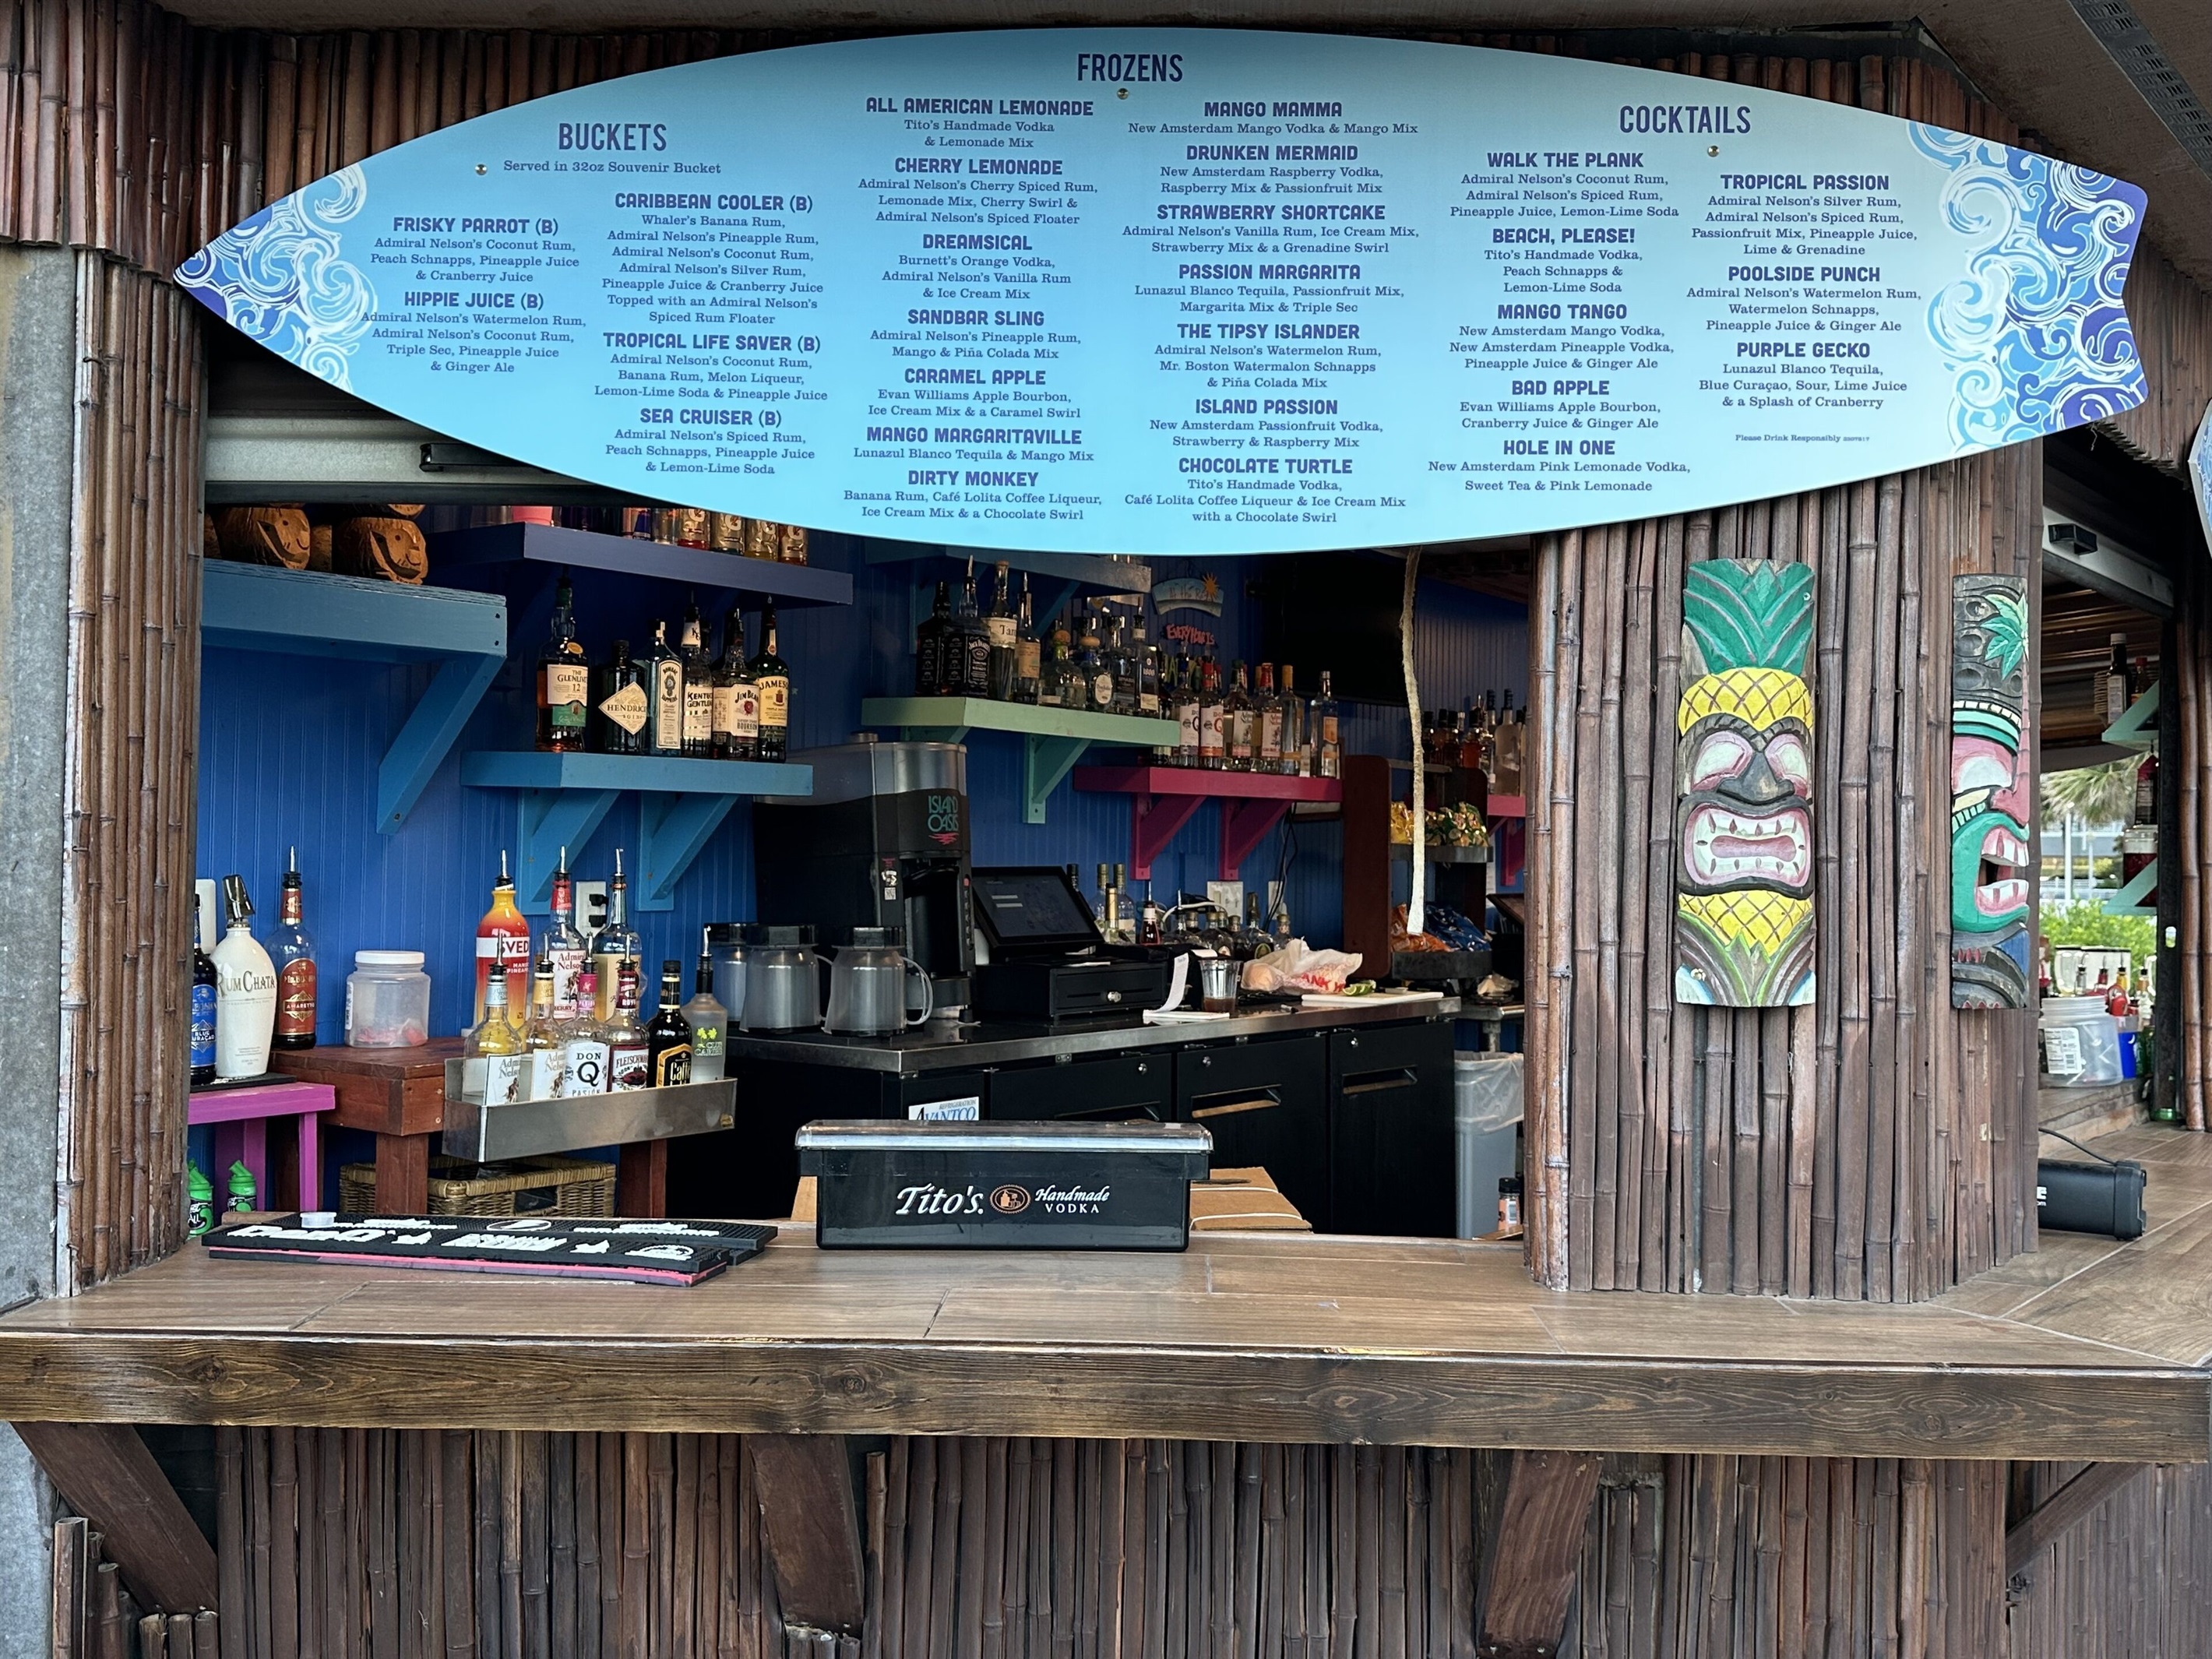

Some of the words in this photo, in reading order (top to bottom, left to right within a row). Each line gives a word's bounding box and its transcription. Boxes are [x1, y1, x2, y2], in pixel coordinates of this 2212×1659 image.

[1078, 54, 1183, 82] FROZENS
[866, 97, 898, 113] ALL
[903, 97, 992, 114] AMERICAN
[999, 100, 1094, 116] LEMONADE
[1204, 102, 1266, 117] MANGO
[1273, 102, 1343, 117] MAMMA
[1620, 106, 1751, 134] COCKTAILS
[559, 123, 667, 151] BUCKETS
[1187, 145, 1269, 160] DRUNKEN
[1276, 145, 1358, 160] MERMAID
[1487, 153, 1538, 167] WALK
[1544, 153, 1579, 167] THE
[1585, 153, 1644, 167] PLANK
[504, 160, 550, 171] Served
[554, 160, 568, 171] in
[572, 161, 604, 172] 32oz
[608, 161, 670, 173] Souvenir
[673, 162, 721, 174] Bucket
[895, 157, 963, 174] CHERRY
[969, 158, 1062, 175] LEMONADE
[1720, 174, 1807, 190] TROPICAL
[1813, 174, 1889, 191] PASSION
[615, 192, 711, 210] CARIBBEAN
[718, 195, 784, 210] COOLER
[790, 195, 813, 214] (B)
[1157, 204, 1276, 220] STRAWBERRY
[1281, 205, 1386, 220] SHORTCAKE
[393, 217, 456, 232] FRISKY
[462, 218, 530, 234] PARROT
[535, 217, 558, 237] (B)
[923, 234, 1033, 251] DREAMSICAL
[1492, 227, 1555, 245] BEACH,
[1562, 227, 1635, 243] PLEASE!
[416, 269, 427, 280] &
[430, 270, 496, 284] Cranberry
[499, 272, 533, 282] Juice
[1179, 264, 1252, 280] PASSION
[1259, 264, 1360, 280] MARGARITA
[1728, 266, 1815, 281] POOLSIDE
[1821, 266, 1880, 282] PUNCH
[404, 291, 460, 308] HIPPIE
[466, 291, 516, 309] JUICE
[520, 292, 544, 312] (B)
[650, 312, 692, 324] Spiced
[695, 312, 725, 322] Rum
[729, 313, 776, 324] Floater
[907, 309, 989, 326] SANDBAR
[994, 311, 1044, 326] SLING
[1498, 304, 1561, 319] MANGO
[1567, 304, 1627, 319] TANGO
[1177, 323, 1212, 339] THE
[1217, 323, 1269, 339] TIPSY
[1275, 324, 1360, 340] ISLANDER
[603, 333, 687, 349] TROPICAL
[693, 334, 730, 350] LIFE
[735, 335, 792, 351] SAVER
[798, 335, 821, 354] (B)
[1737, 342, 1806, 358] PURPLE
[1812, 342, 1870, 358] GECKO
[905, 368, 986, 384] CARAMEL
[992, 369, 1046, 385] APPLE
[1512, 380, 1547, 396] BAD
[1553, 380, 1610, 396] APPLE
[1700, 380, 1729, 390] Blue
[1733, 379, 1791, 393] Curaçao,
[1796, 380, 1830, 392] Sour,
[1834, 380, 1868, 390] Lime
[1872, 381, 1907, 391] Juice
[878, 389, 911, 400] Evan
[914, 389, 969, 400] Williams
[972, 391, 1009, 403] Apple
[1013, 391, 1072, 403] Bourbon,
[1196, 399, 1257, 414] ISLAND
[1263, 399, 1338, 415] PASSION
[640, 408, 673, 424] SEA
[680, 409, 753, 425] CRUISER
[759, 410, 782, 428] (B)
[867, 427, 928, 442] MANGO
[935, 428, 1082, 445] MARGARITAVILLE
[1173, 436, 1245, 449] Strawberry
[1249, 436, 1259, 446] &
[1263, 436, 1330, 449] Raspberry
[1333, 437, 1360, 447] Mix
[1791, 435, 1841, 443] Responsibly
[1503, 439, 1549, 455] HOLE
[1555, 440, 1573, 455] IN
[1580, 440, 1615, 456] ONE
[1179, 457, 1279, 474] CHOCOLATE
[1284, 459, 1353, 474] TURTLE
[908, 470, 960, 485] DIRTY
[965, 471, 1039, 487] MONKEY
[1465, 480, 1503, 491] Sweet
[1508, 481, 1531, 491] Tea
[1534, 481, 1545, 491] &
[1550, 481, 1580, 491] Pink
[1584, 481, 1653, 491] Lemonade
[928, 795, 959, 814] ISLAND
[928, 814, 960, 832] OASIS
[576, 1061, 600, 1087] Q
[1034, 1184, 1111, 1202] Handmade
[1044, 1203, 1100, 1214] VODKA
